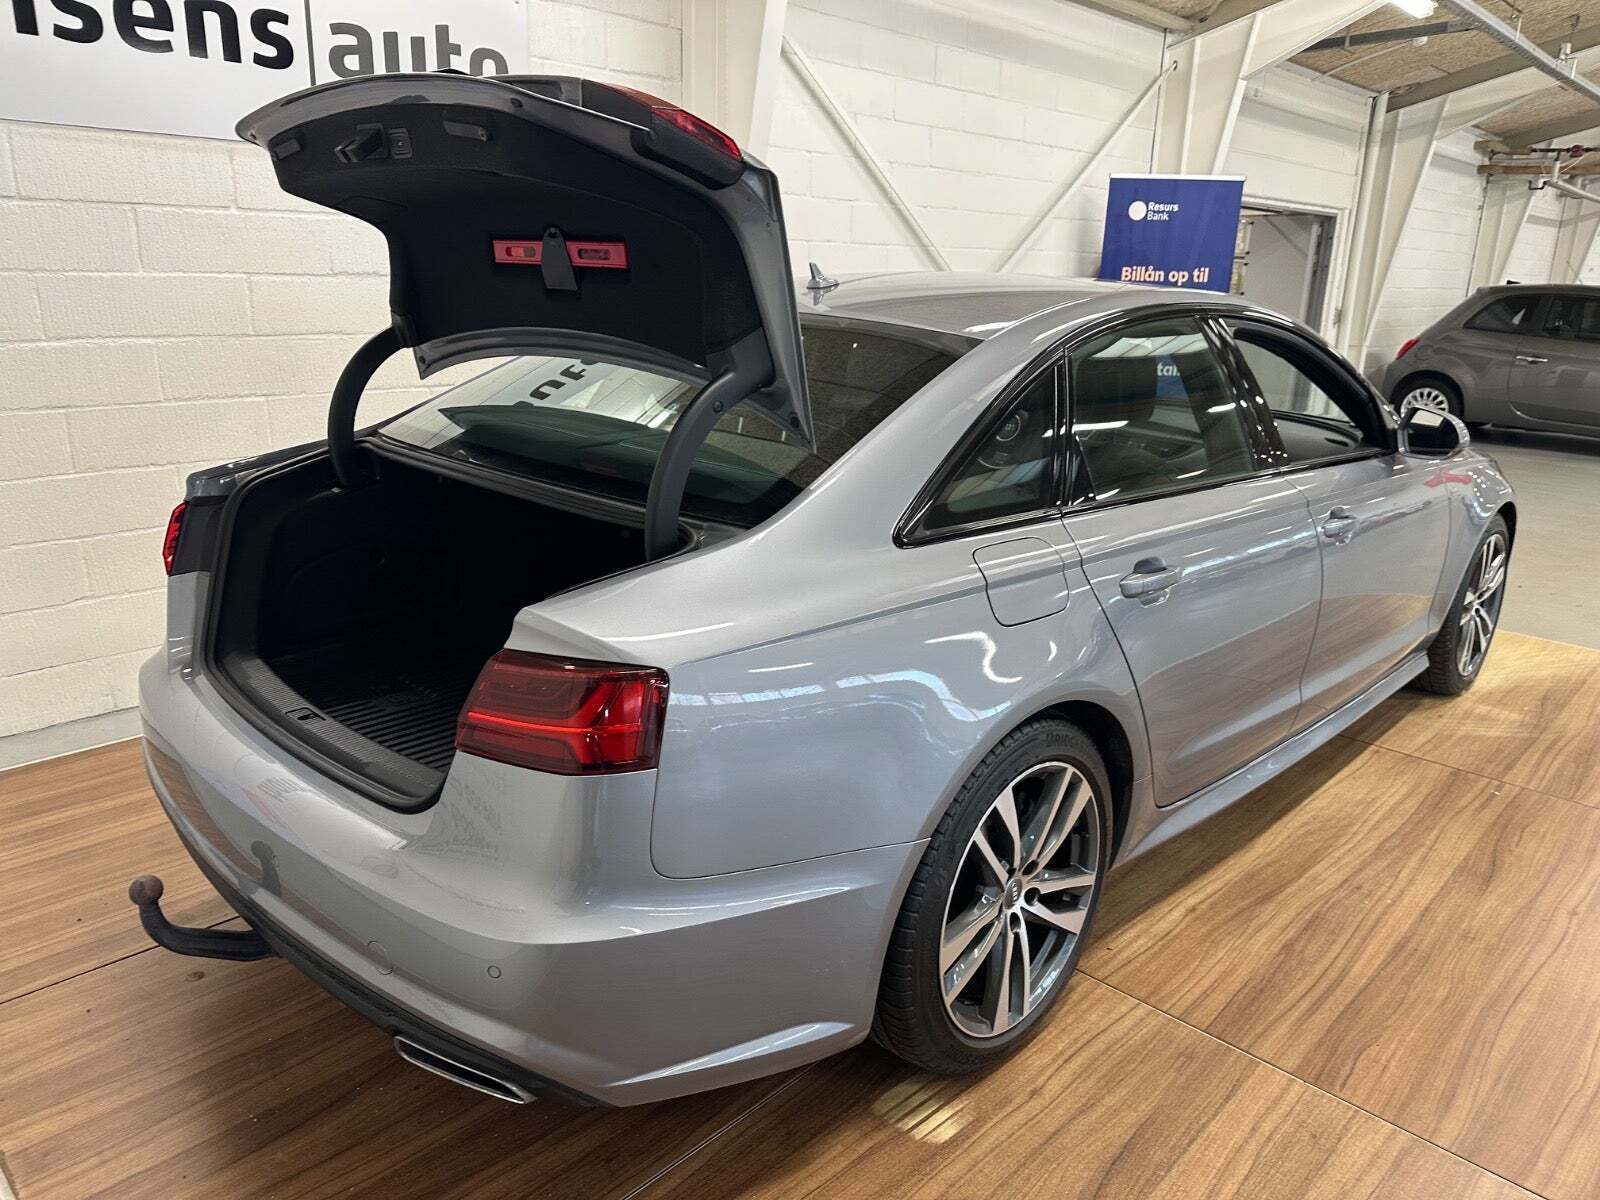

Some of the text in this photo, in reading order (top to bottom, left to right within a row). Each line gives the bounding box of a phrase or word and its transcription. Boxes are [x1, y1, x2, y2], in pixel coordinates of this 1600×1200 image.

[328, 22, 510, 79] auto
[1148, 201, 1179, 212] Resurs
[1147, 211, 1169, 221] Bank
[1121, 265, 1209, 286] Billån op til
